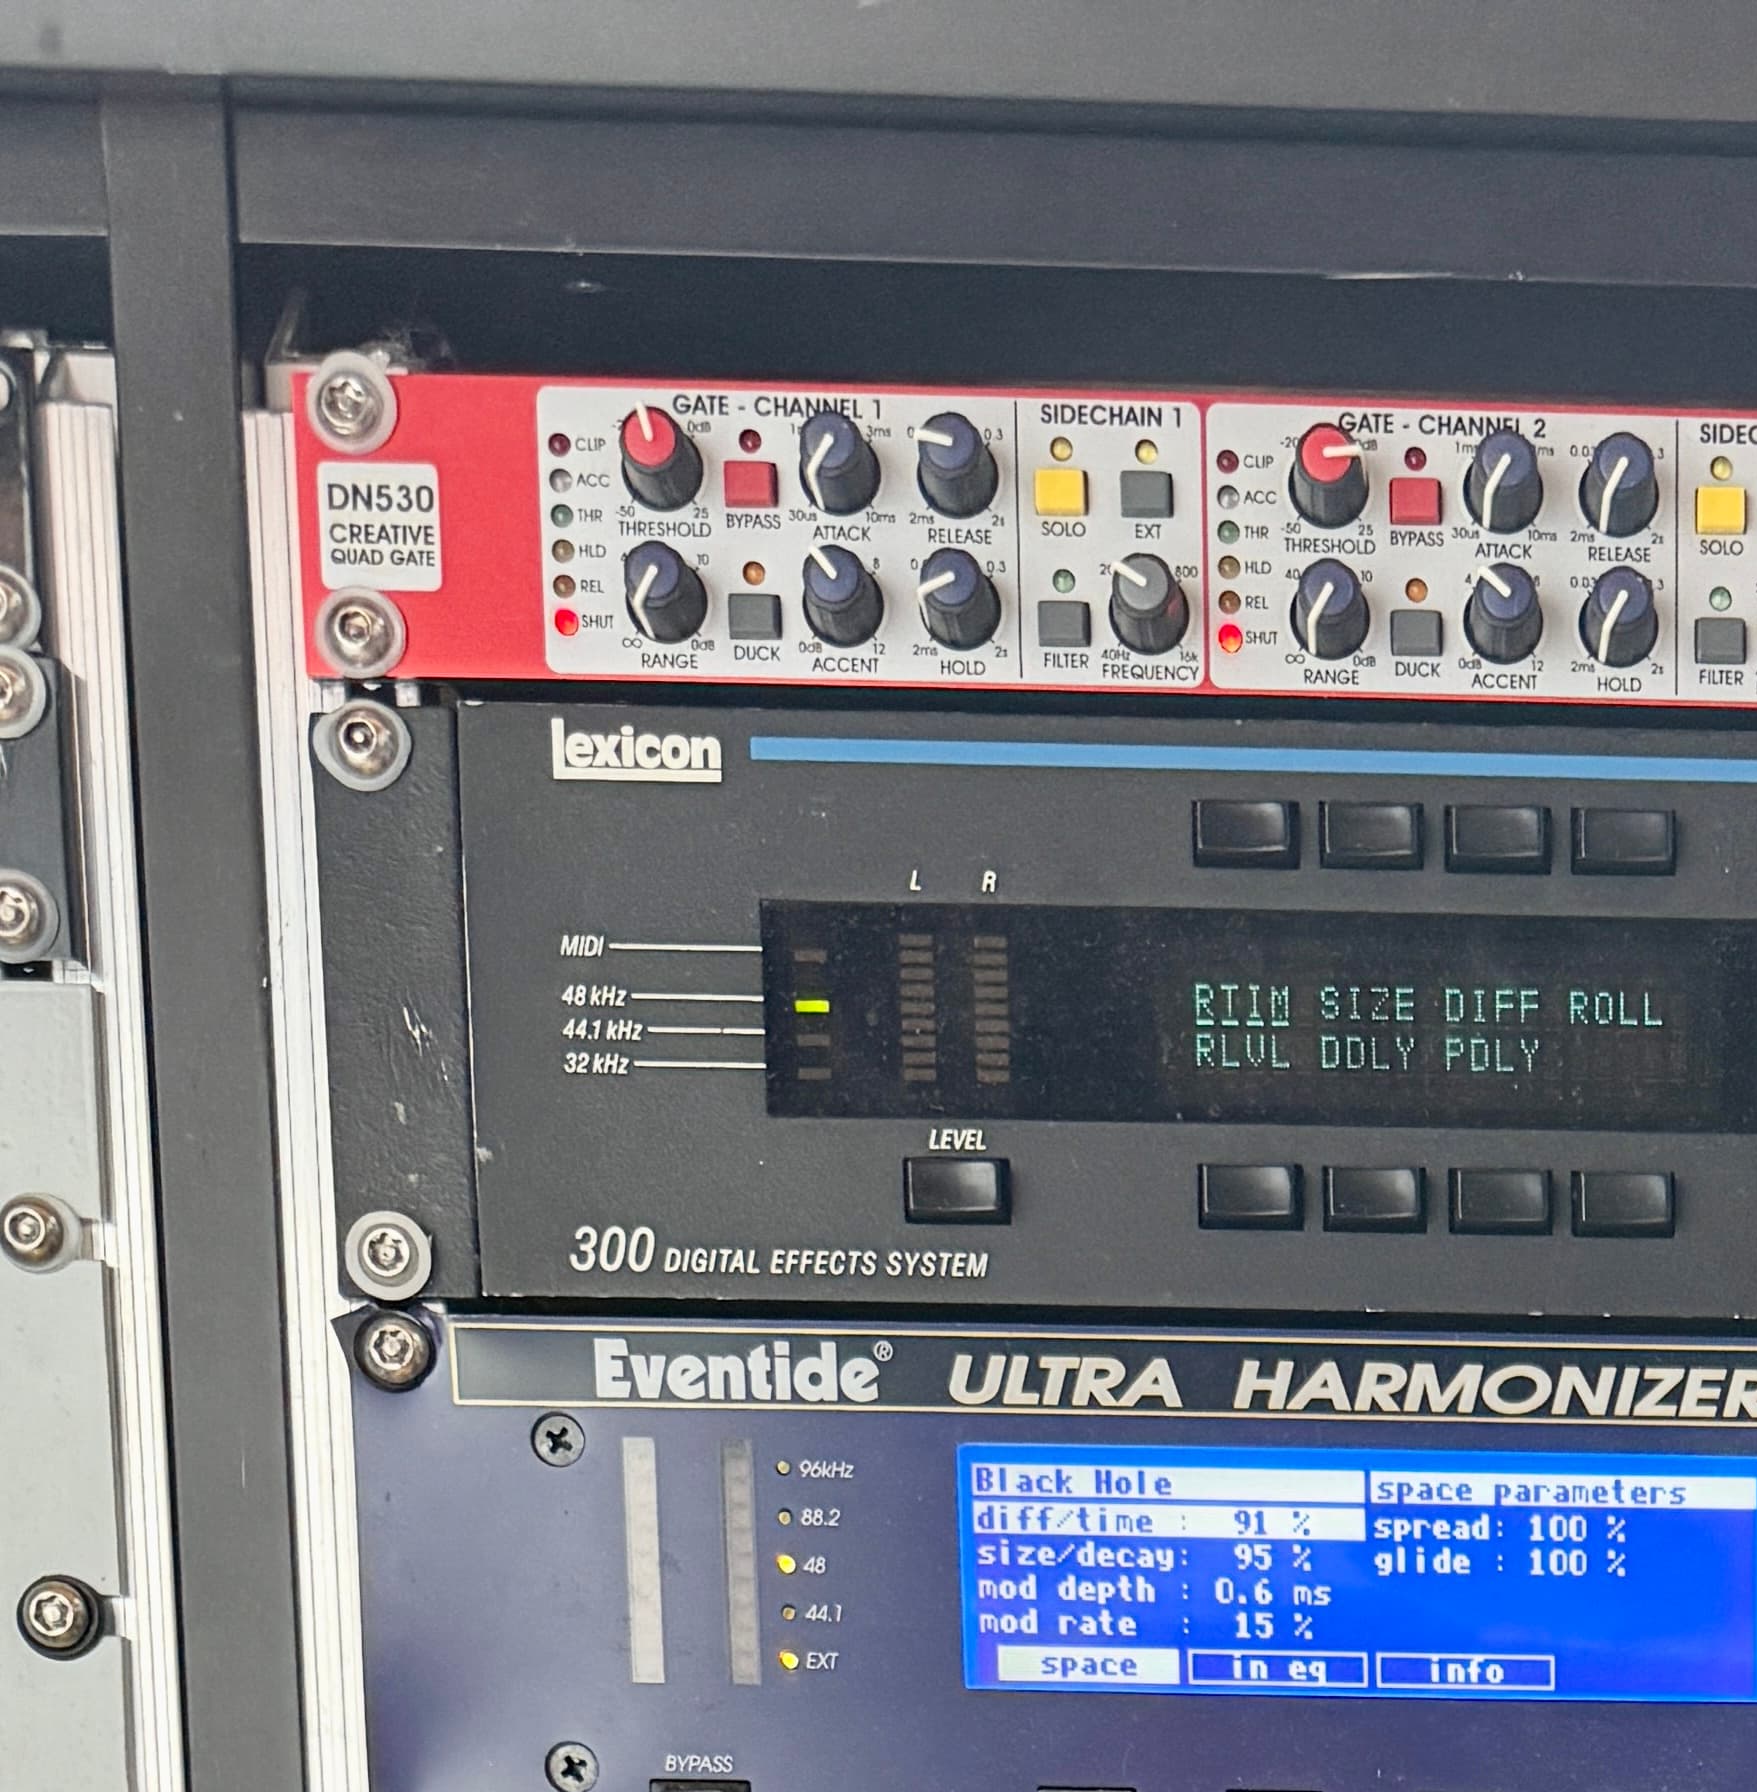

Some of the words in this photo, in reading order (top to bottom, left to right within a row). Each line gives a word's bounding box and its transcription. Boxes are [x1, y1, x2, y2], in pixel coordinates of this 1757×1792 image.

[1040, 405, 1162, 425] SIDECHAIN
[1174, 405, 1182, 427] 1
[327, 483, 434, 512] DN530
[330, 522, 435, 545] CREATIVE
[330, 549, 387, 566] QUAD
[389, 548, 436, 567] GATE
[1195, 983, 1290, 1026] RTIM
[1321, 988, 1414, 1022] SIZE
[1445, 988, 1539, 1023] DIFF
[1570, 991, 1662, 1026] ROLL
[1321, 1037, 1414, 1070] DDLY
[1446, 1038, 1539, 1072] PDLY
[570, 1227, 655, 1272] 300
[665, 1249, 760, 1273] DIGITAL
[770, 1251, 877, 1275] EFFECTS
[886, 1252, 988, 1277] SYSTEM
[949, 1355, 1182, 1407] ULTRA
[975, 1471, 1073, 1495] Black
[1094, 1473, 1172, 1496] Hole
[1378, 1480, 1473, 1505] space
[1494, 1480, 1686, 1507] parameters
[977, 1507, 1153, 1534] diff/time
[1233, 1511, 1268, 1535] 91
[1292, 1511, 1311, 1535] %
[1374, 1514, 1503, 1542] spread:
[1528, 1515, 1586, 1542] 100
[979, 1579, 1036, 1603] mod
[1058, 1577, 1156, 1605] depth
[1215, 1579, 1272, 1605] 0.6
[1293, 1584, 1331, 1605] ms
[1041, 1653, 1137, 1678] space
[1430, 1659, 1504, 1684] info
